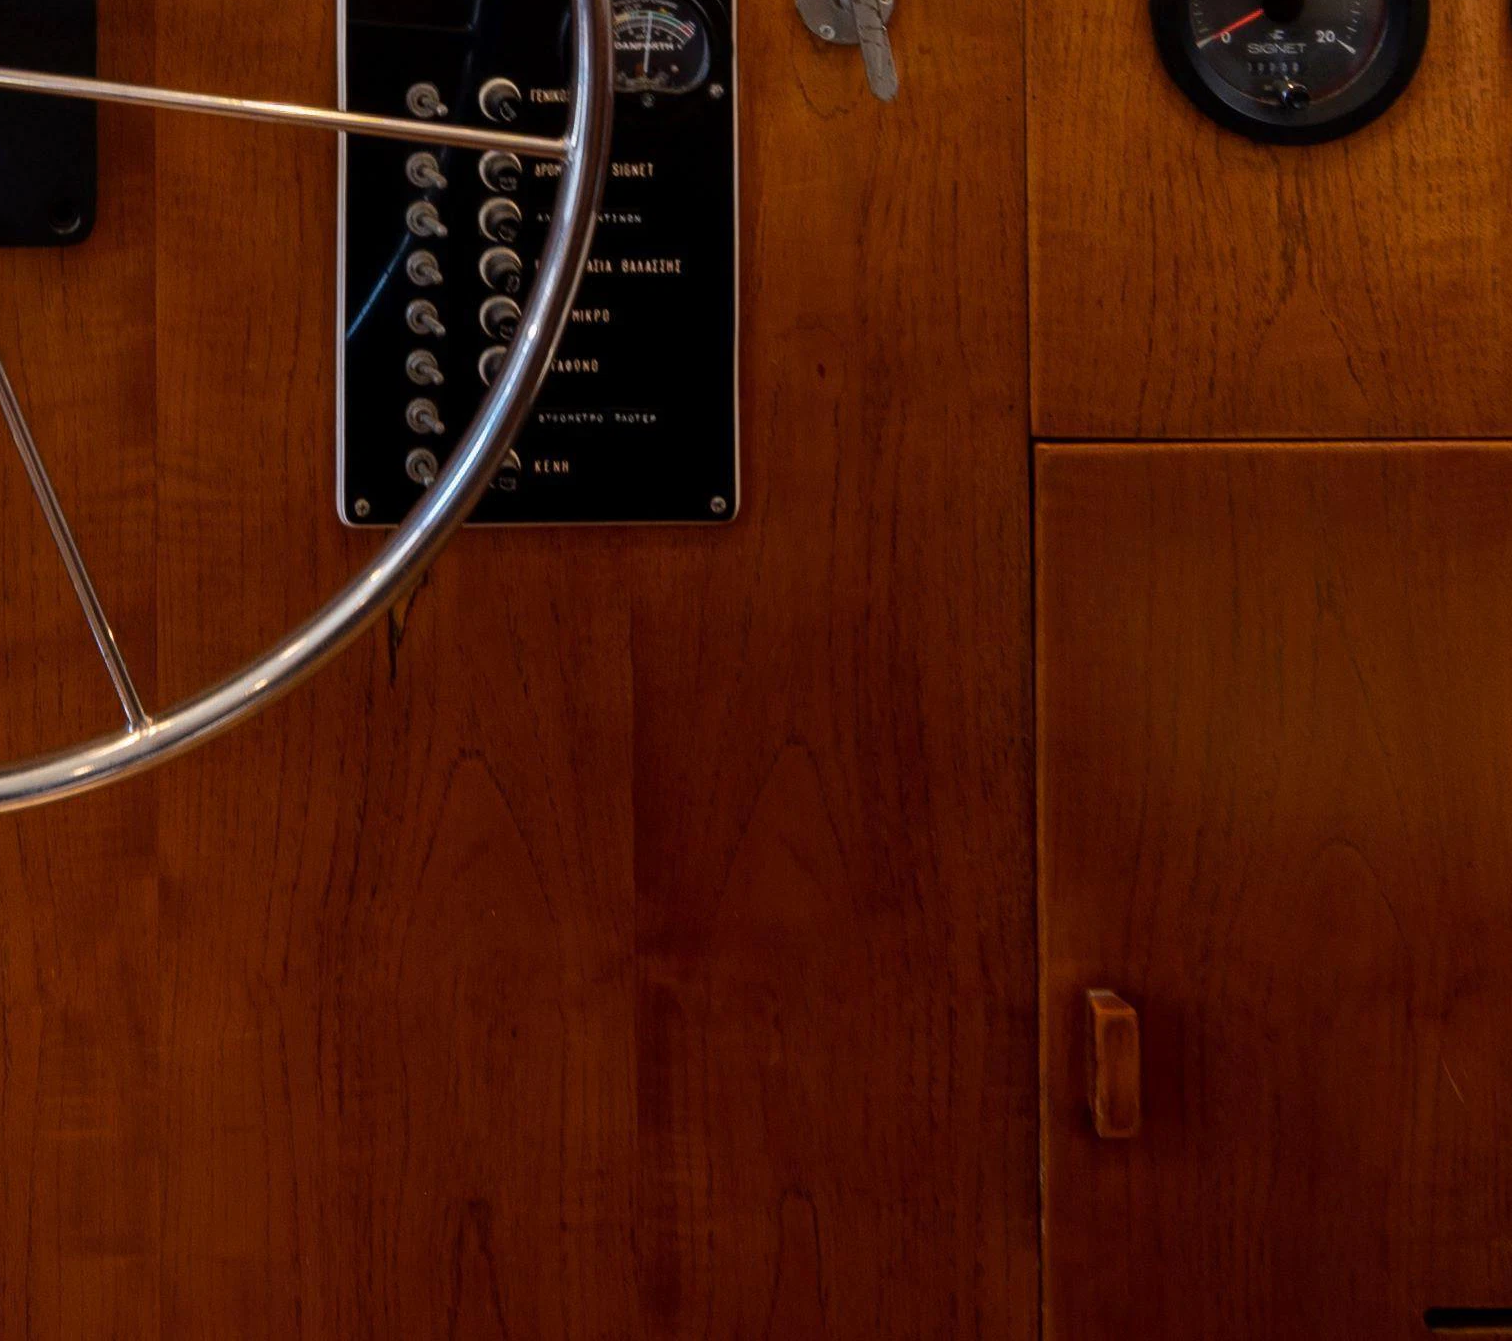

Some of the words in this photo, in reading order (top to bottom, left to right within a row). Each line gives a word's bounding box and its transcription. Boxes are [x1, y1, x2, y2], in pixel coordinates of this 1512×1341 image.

[1221, 30, 1232, 44] 0
[1315, 29, 1336, 44] 20
[1247, 43, 1307, 54] SIGNET
[612, 162, 654, 177] SIGNET
[620, 258, 681, 274] ΘΑΛΑΣΣΗΣ
[534, 459, 569, 473] ΚΕΝΗ
